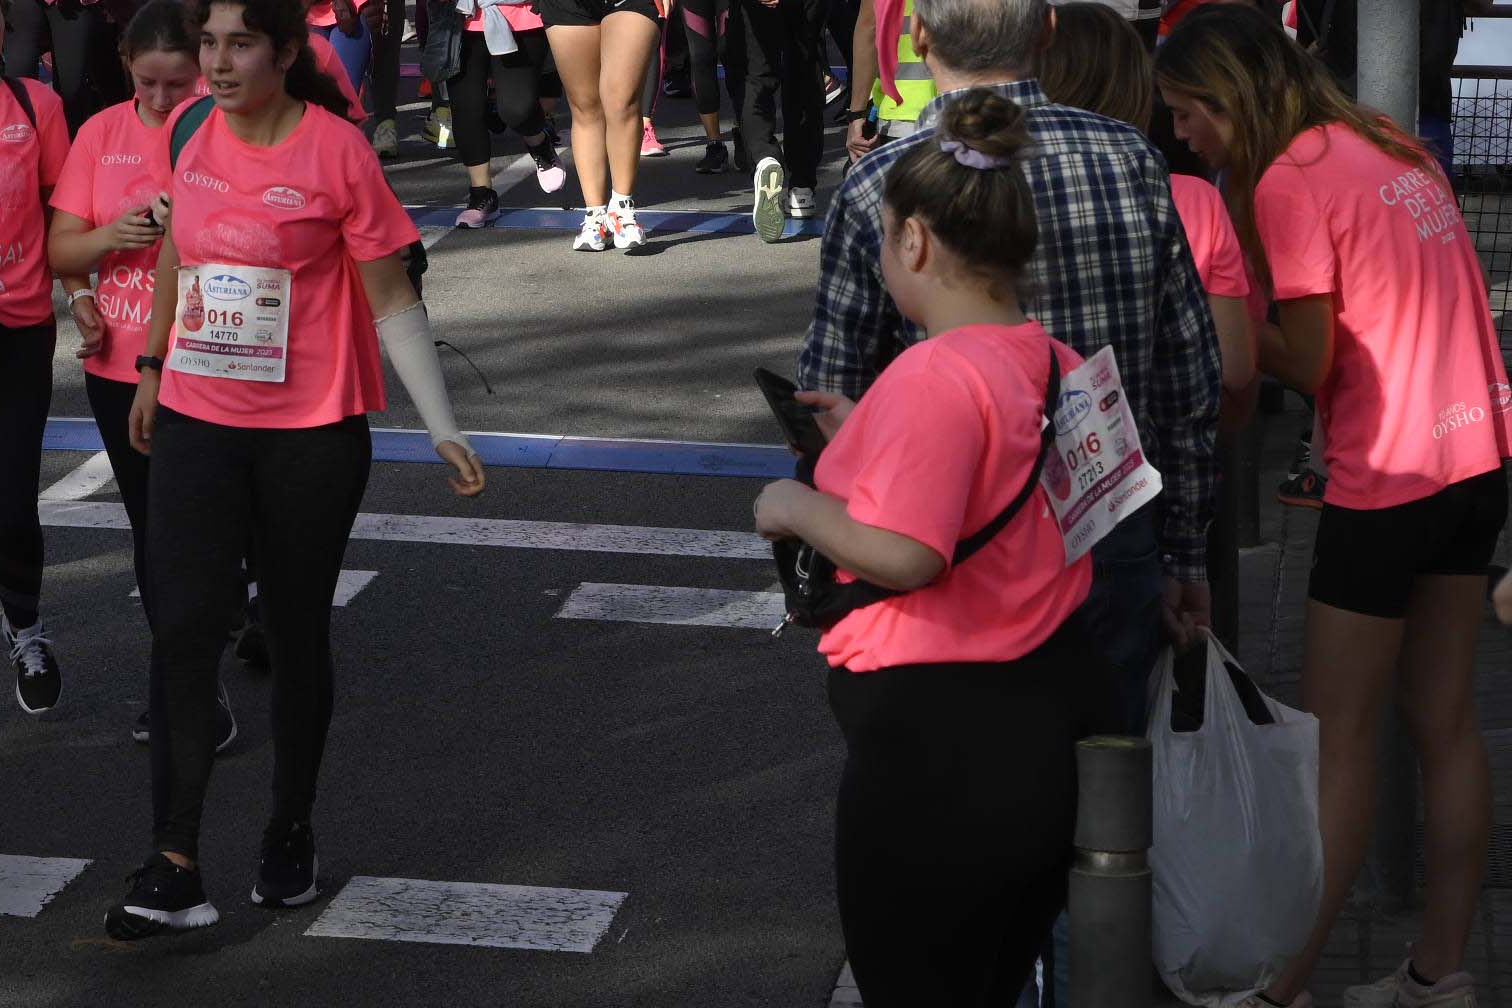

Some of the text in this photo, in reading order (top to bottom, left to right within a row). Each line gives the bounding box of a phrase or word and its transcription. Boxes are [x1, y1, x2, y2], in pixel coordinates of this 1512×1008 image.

[101, 154, 142, 166] OYSHO
[183, 171, 230, 193] OYSHO
[1379, 164, 1438, 206] CARRE
[264, 191, 302, 207] ASTURIANA
[1404, 186, 1447, 219] DE LA
[1416, 203, 1460, 242] MUJER
[206, 282, 248, 297] ASTURIANA
[256, 283, 281, 291] SUMA
[207, 308, 244, 327] 016
[209, 329, 239, 342] 14770
[185, 341, 210, 351] CARRERA
[211, 344, 220, 352] DE
[220, 345, 229, 353] LA
[230, 347, 254, 355] MUJER
[236, 361, 275, 373] Santander
[1432, 406, 1485, 440] OYSHO
[1066, 432, 1101, 471] 016
